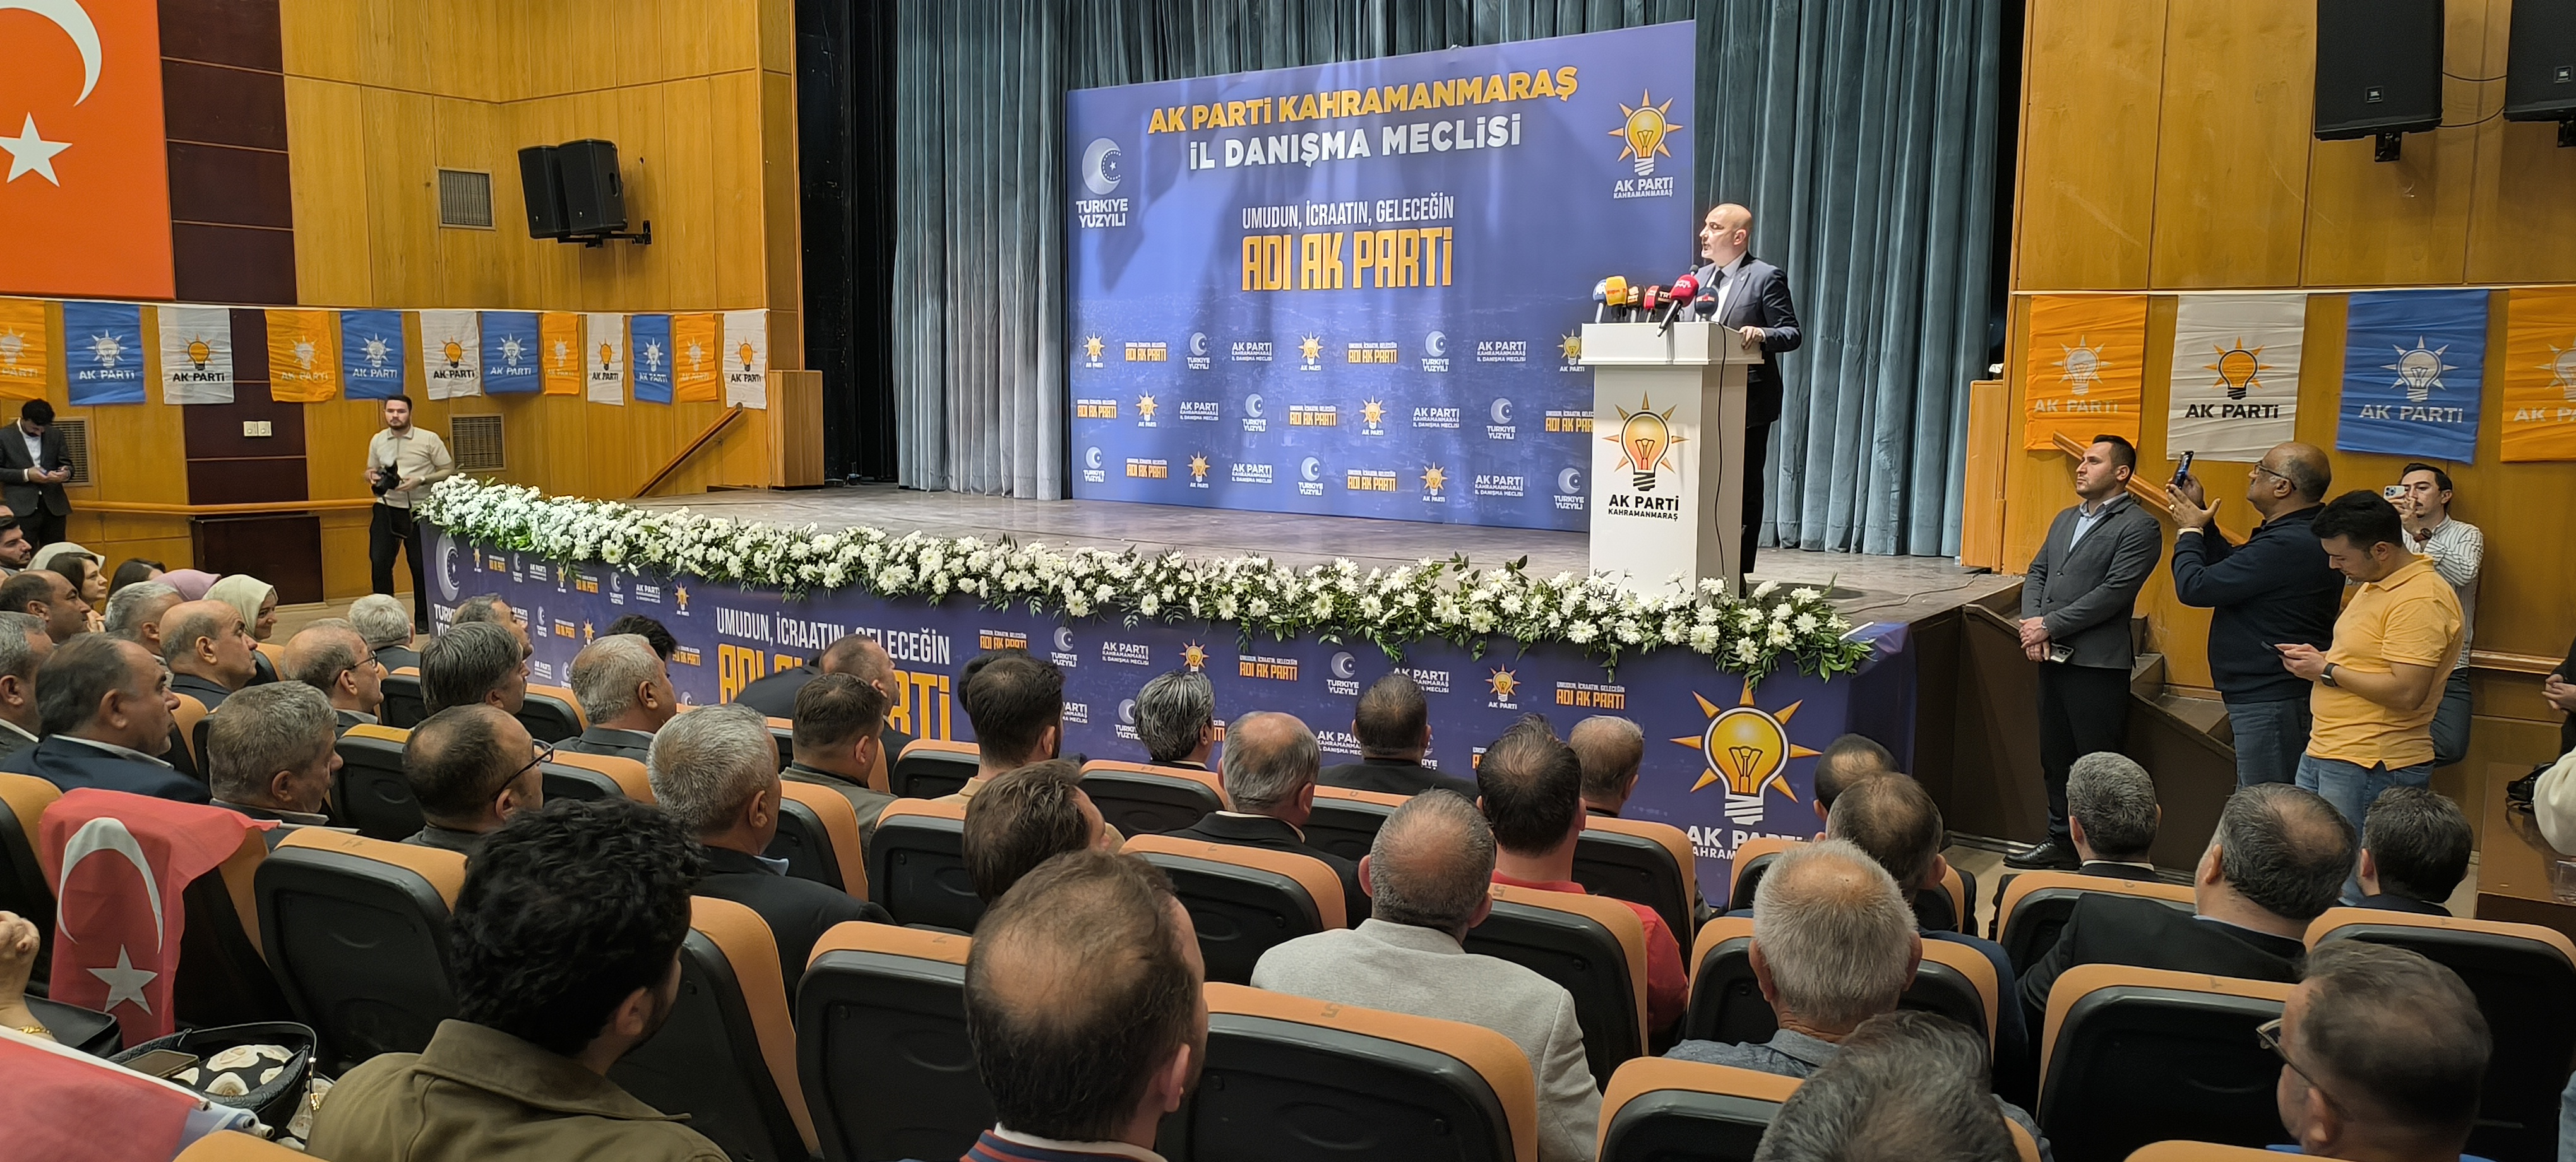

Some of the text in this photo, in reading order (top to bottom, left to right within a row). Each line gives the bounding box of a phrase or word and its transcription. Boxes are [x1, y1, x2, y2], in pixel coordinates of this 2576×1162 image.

[1148, 66, 1578, 134] AK PARTİ KAHRAMANMARAŞ
[1190, 113, 1520, 170] İL DANIŞMA MECLİSİ
[1614, 177, 1673, 192] AK PARTİ
[1614, 189, 1673, 198] KAHRAMANMARAŞ
[1243, 192, 1454, 230] UMUDUN, İCRAATIN, GELECEĞİN
[1242, 227, 1452, 290] ADI AK PARTİ
[1232, 342, 1244, 350] AK
[1478, 342, 1493, 350] AK
[1348, 349, 1361, 363] ADI
[1362, 349, 1373, 363] AK
[80, 371, 95, 380] AK
[173, 373, 191, 381] AK
[353, 368, 367, 377] AK
[434, 370, 445, 378] AK
[730, 374, 742, 383] AK
[1180, 402, 1192, 410] AK
[1414, 408, 1428, 416] AK
[2034, 399, 2118, 414] AK PARTİ
[2185, 404, 2279, 419] AK PARTİ
[2358, 405, 2463, 422] AK PARTİ
[2513, 407, 2546, 422] AK
[1546, 417, 1574, 432] ADI AK
[1232, 464, 1245, 472] AK
[1476, 475, 1491, 484] AK
[1609, 494, 1679, 511] AK PARTİ
[1608, 508, 1678, 522] KAHRAMANMARAŞ
[717, 607, 773, 647] UMUDUN,
[980, 635, 992, 649] ADI
[994, 636, 1003, 649] AK
[1102, 641, 1116, 651] AK
[1240, 662, 1254, 676] ADI
[1256, 664, 1268, 678] AK
[1556, 689, 1573, 705] ADI
[1577, 691, 1590, 707] AK
[1318, 731, 1334, 741] AK
[1686, 825, 1723, 848] AK
